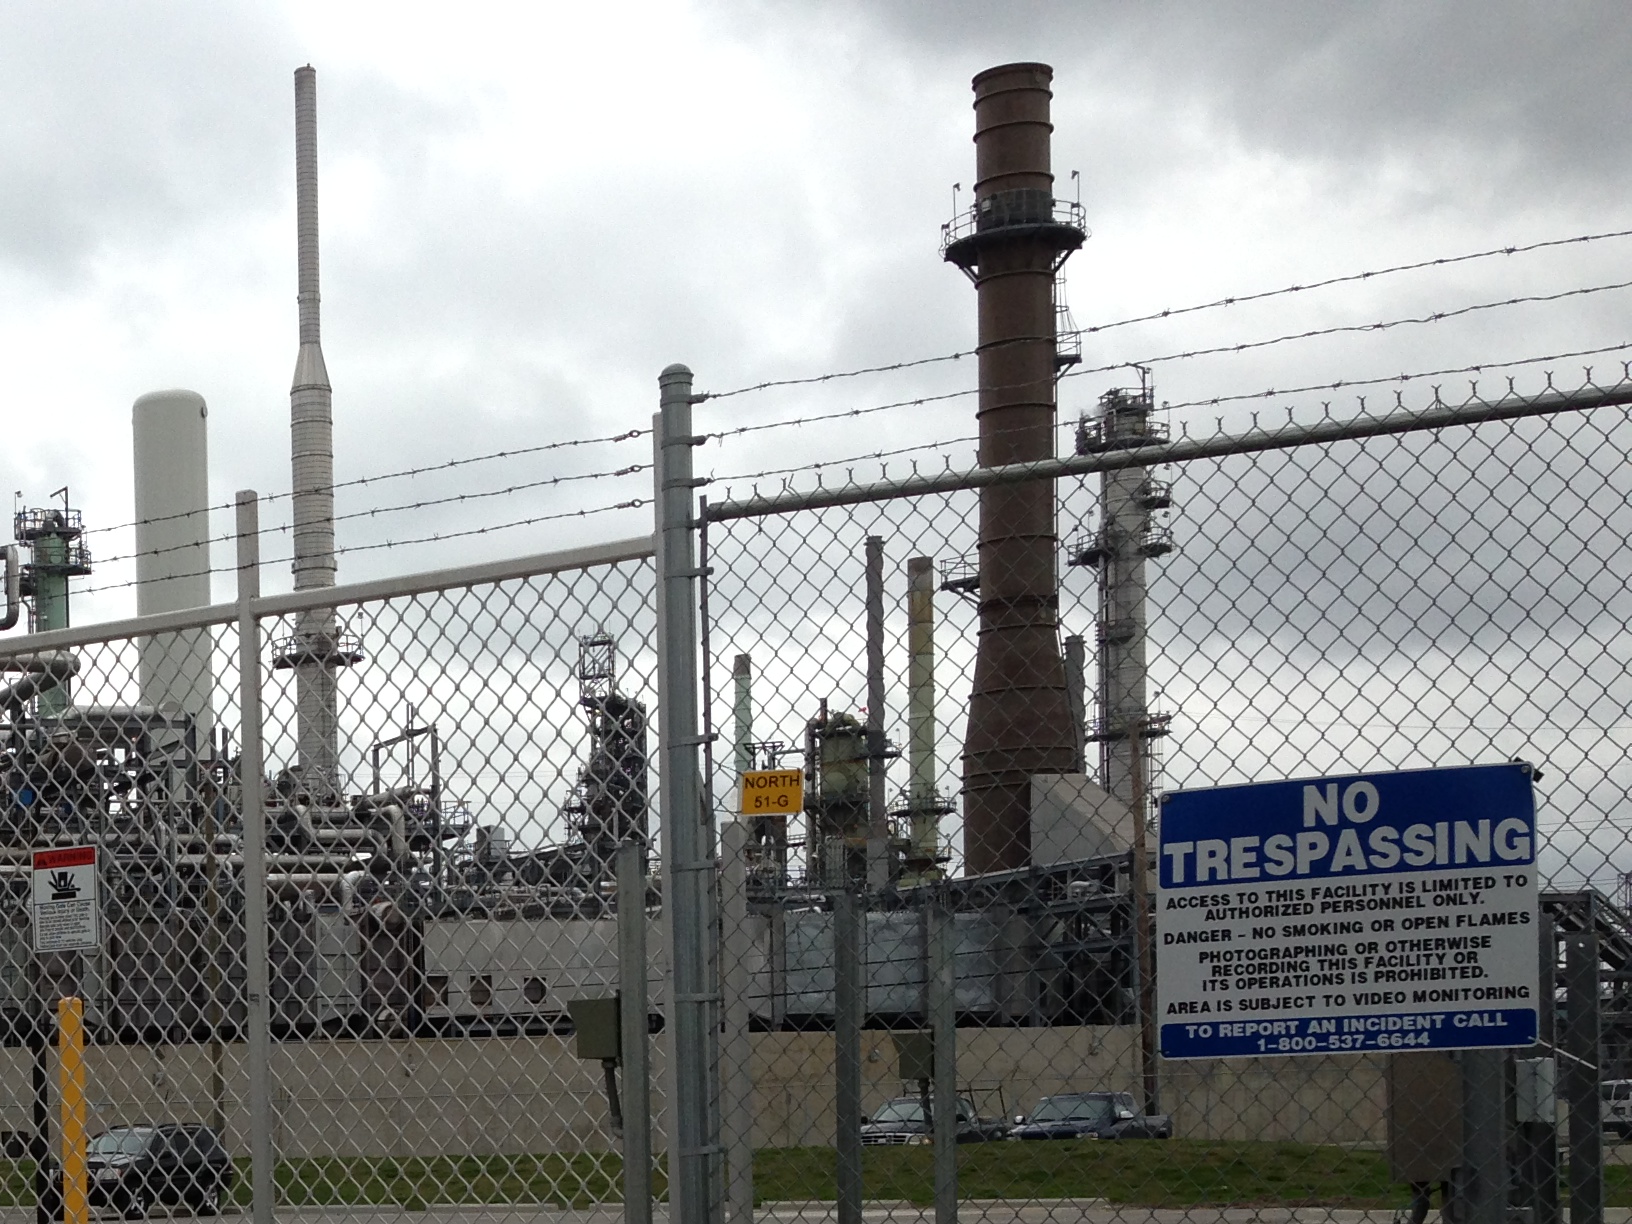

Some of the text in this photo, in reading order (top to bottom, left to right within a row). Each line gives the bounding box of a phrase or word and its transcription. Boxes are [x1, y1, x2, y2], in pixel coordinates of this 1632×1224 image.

[745, 774, 800, 789] NORTH
[754, 795, 789, 808] 51-G
[1304, 781, 1379, 827] NO
[49, 850, 93, 863] WARNING
[1164, 818, 1530, 883] TRESPASSING
[1166, 874, 1528, 910] ACCESS TO THIS FACILITY IS LIMITED TO
[1204, 891, 1485, 922] AUTHORIZED PERSONNEL ONLY.
[1164, 929, 1232, 945] DANGER
[1252, 926, 1276, 940] NO
[1282, 921, 1364, 938] SMOKING
[1370, 919, 1395, 932] OR
[1401, 915, 1450, 930] OPEN
[1456, 911, 1531, 928] FLAMES
[1199, 935, 1492, 964] PHOTOGRAPHING OR OTHERWISE
[1211, 951, 1478, 977] RECORDING THIS FACILITY OR
[1202, 965, 1489, 992] ITS OPERATIONS IS PROHIBITED.
[1166, 985, 1530, 1015] AREA IS SUBJECT TO VIDEO MONITORING
[1186, 1013, 1507, 1038] TO REPORT AN INCIDENT CALL
[1258, 1032, 1429, 1051] 1-800-537-6644
